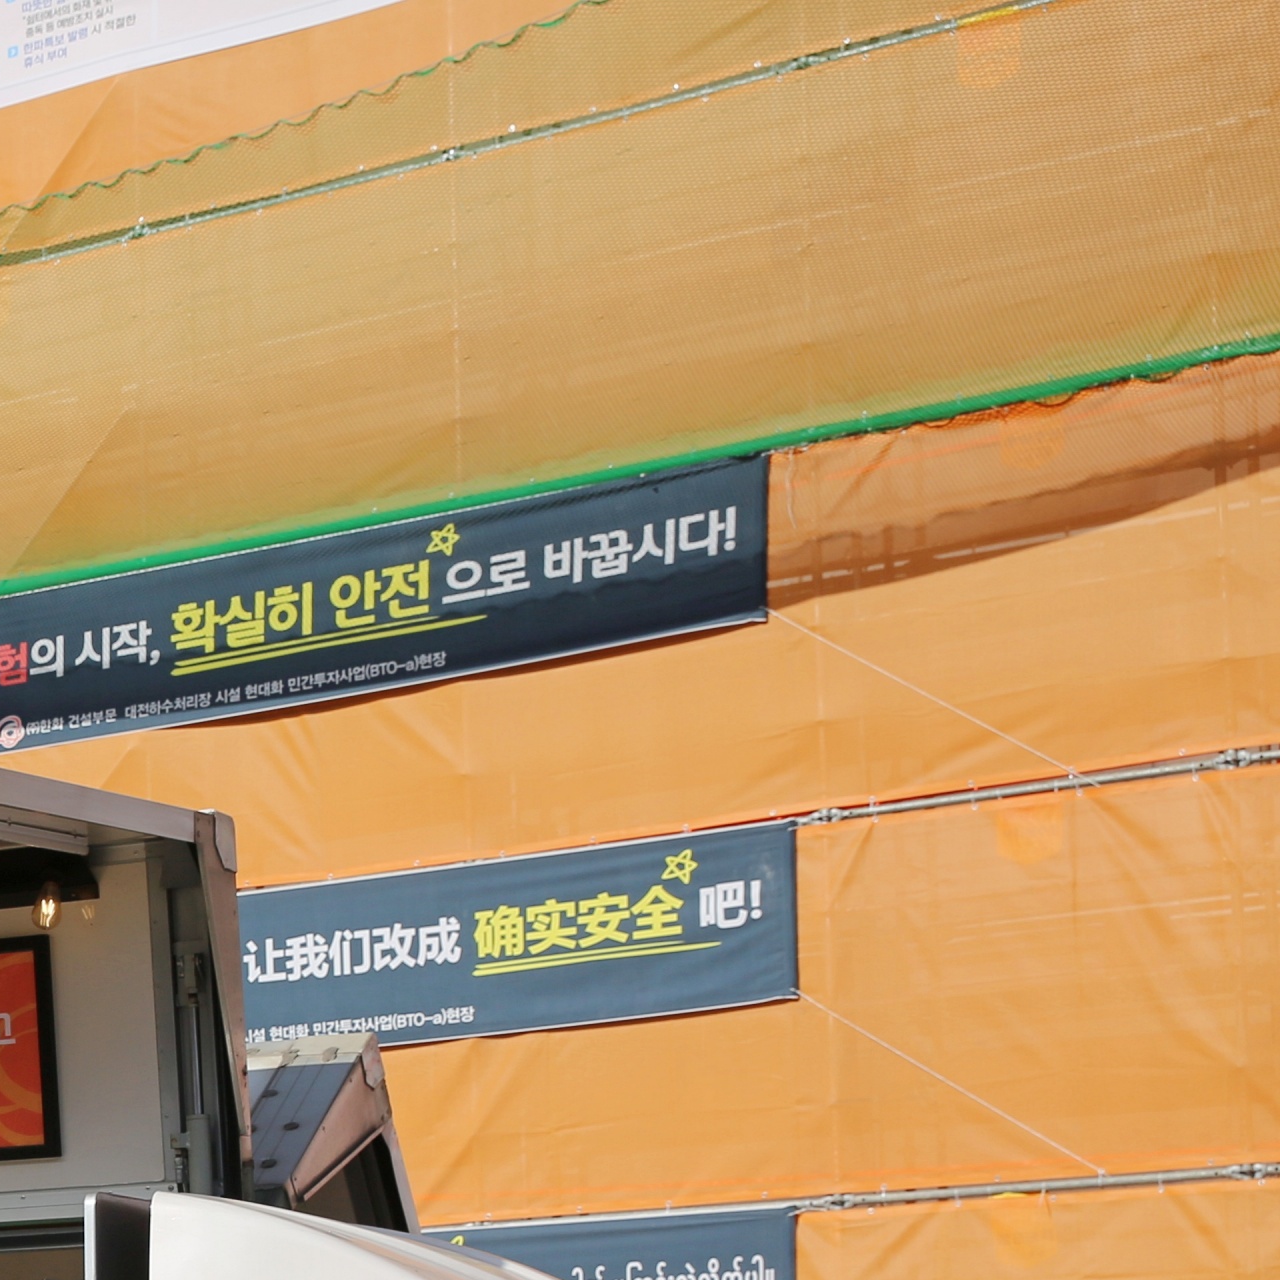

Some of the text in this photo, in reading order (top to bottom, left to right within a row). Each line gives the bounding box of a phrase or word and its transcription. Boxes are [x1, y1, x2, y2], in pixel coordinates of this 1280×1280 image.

[73, 620, 162, 671] 시작,
[169, 580, 314, 655] 확실히
[543, 505, 738, 585] 바꿉시다!
[67, 707, 118, 730] 건설부문
[124, 690, 212, 720] 대전하수처리장
[214, 684, 242, 706] 시설
[244, 677, 285, 700] 현대화
[243, 883, 685, 984] 让我们改成 确实安全
[269, 1021, 310, 1042] 현대화
